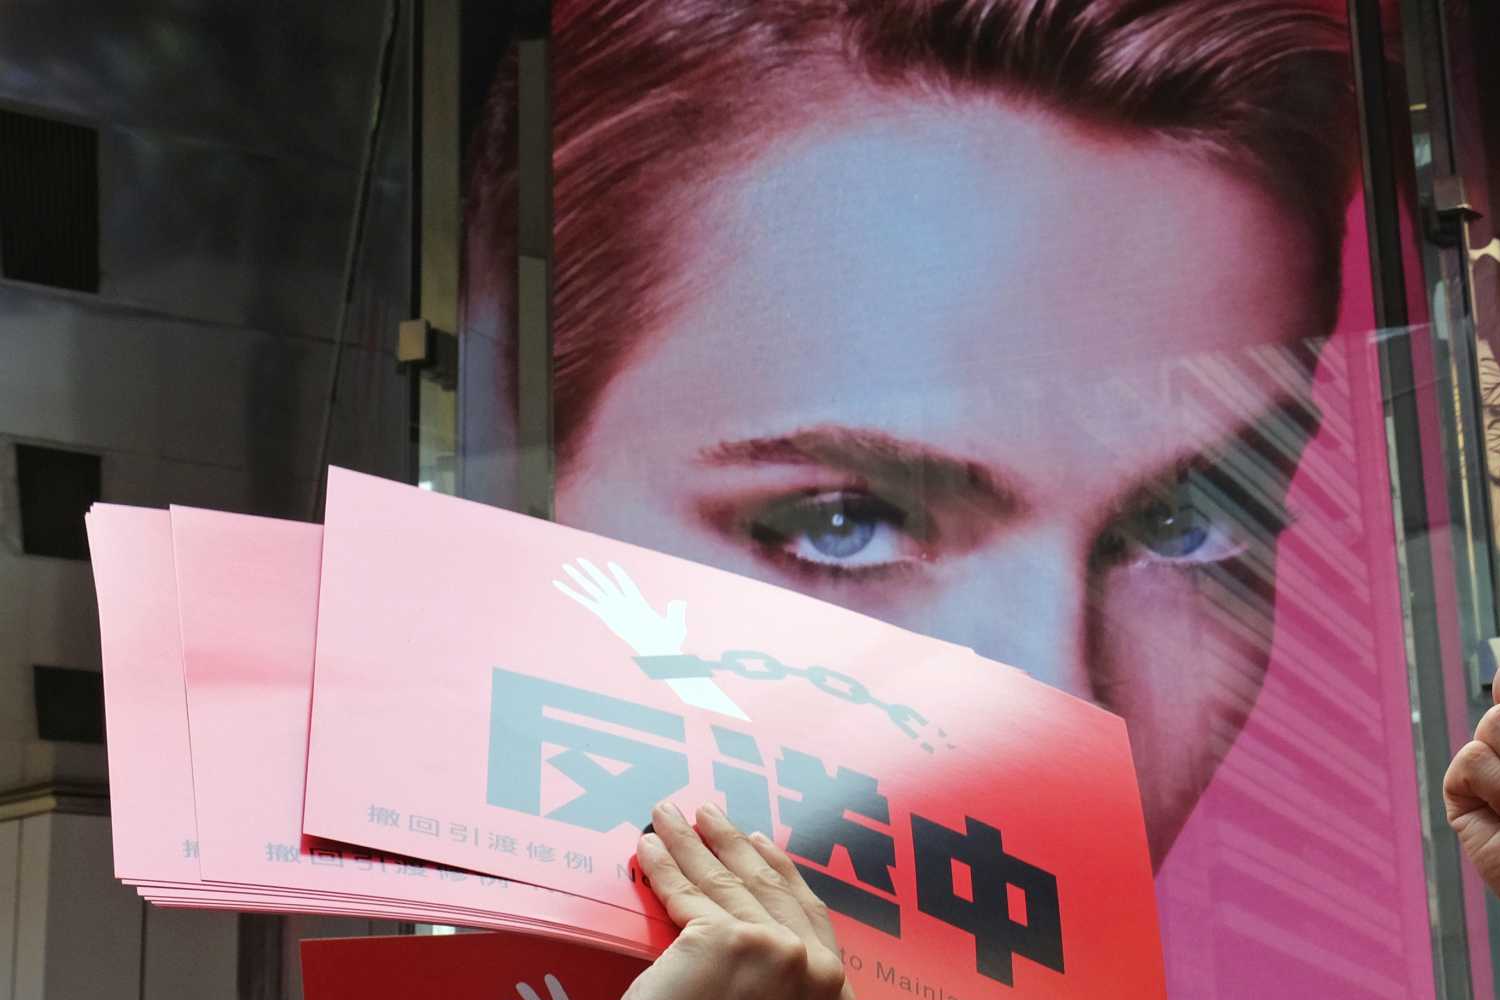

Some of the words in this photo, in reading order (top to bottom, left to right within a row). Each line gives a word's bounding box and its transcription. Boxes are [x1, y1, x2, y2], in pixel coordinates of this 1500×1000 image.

[367, 803, 594, 874] 撤回引渡修例
[486, 667, 1065, 988] 反送中
